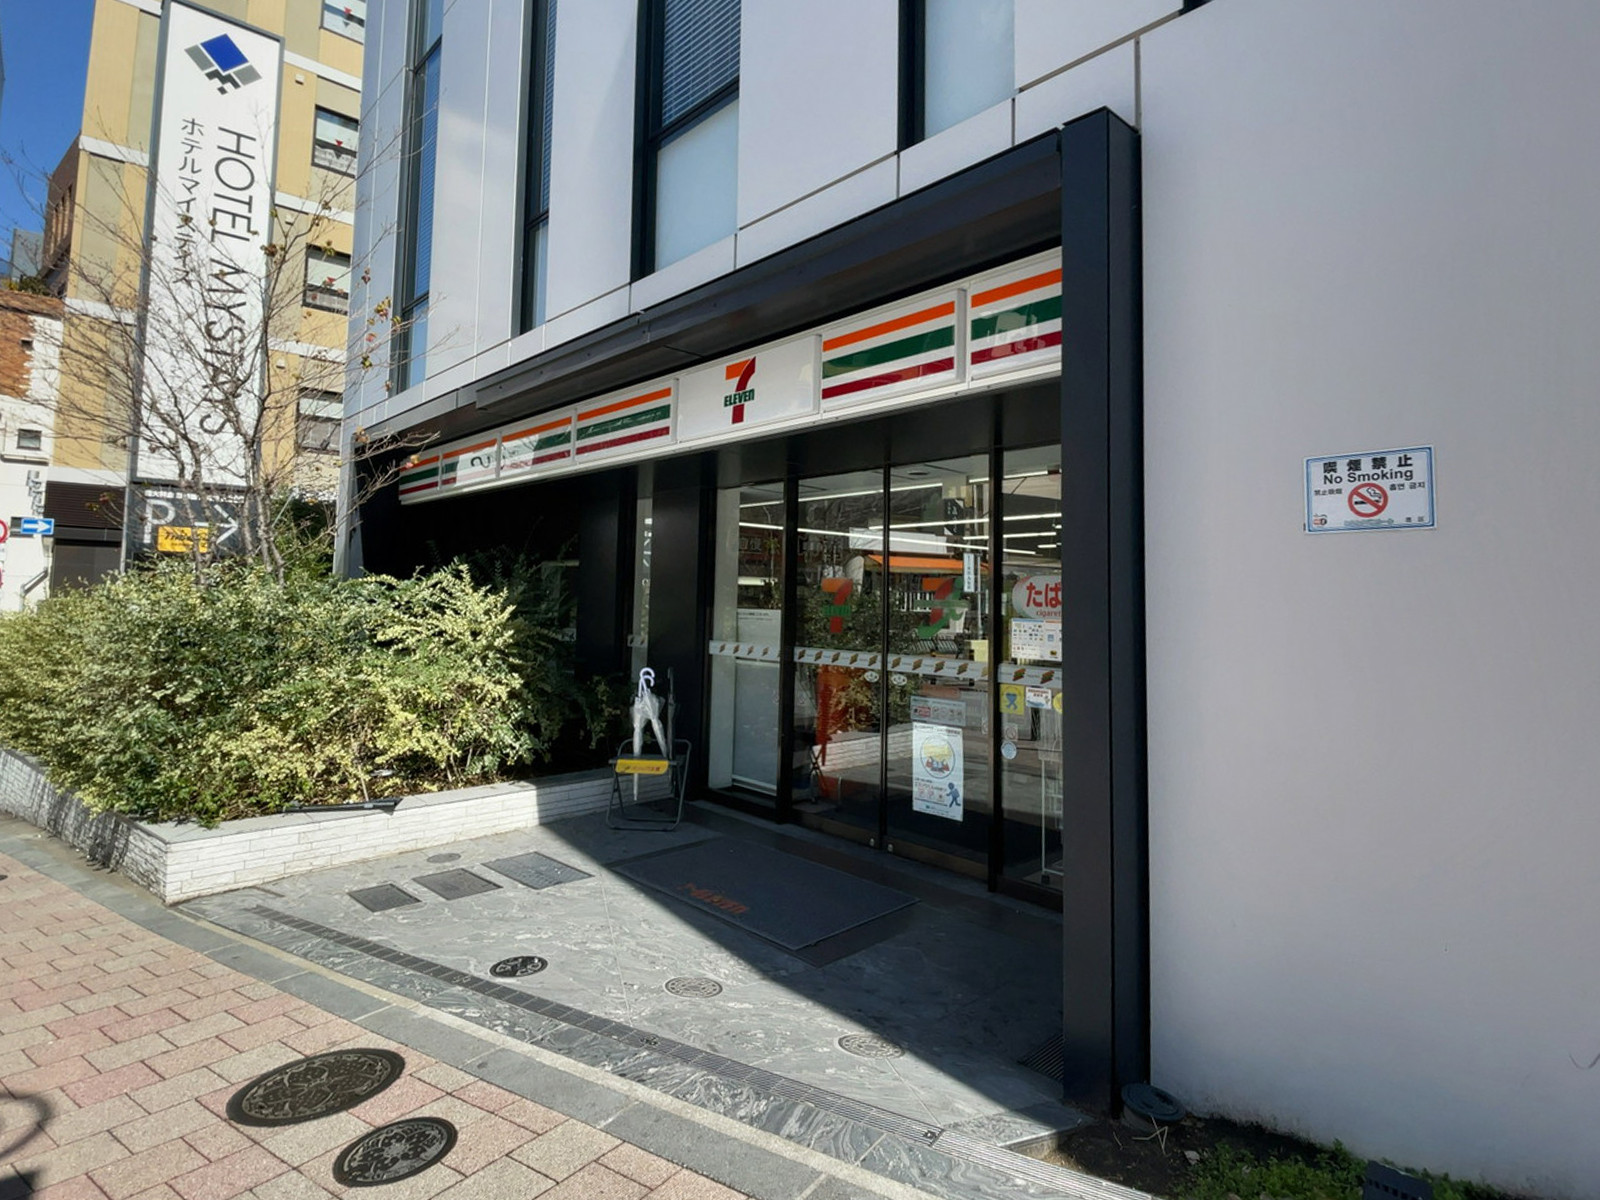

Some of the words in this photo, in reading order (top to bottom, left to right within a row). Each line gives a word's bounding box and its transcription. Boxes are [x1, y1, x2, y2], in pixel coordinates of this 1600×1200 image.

[210, 126, 256, 242] HOTEL
[725, 355, 756, 424] 7
[1322, 454, 1413, 473] 喫煙禁止
[1323, 474, 1343, 485] No
[1347, 468, 1414, 483] Smoking
[143, 498, 176, 544] P
